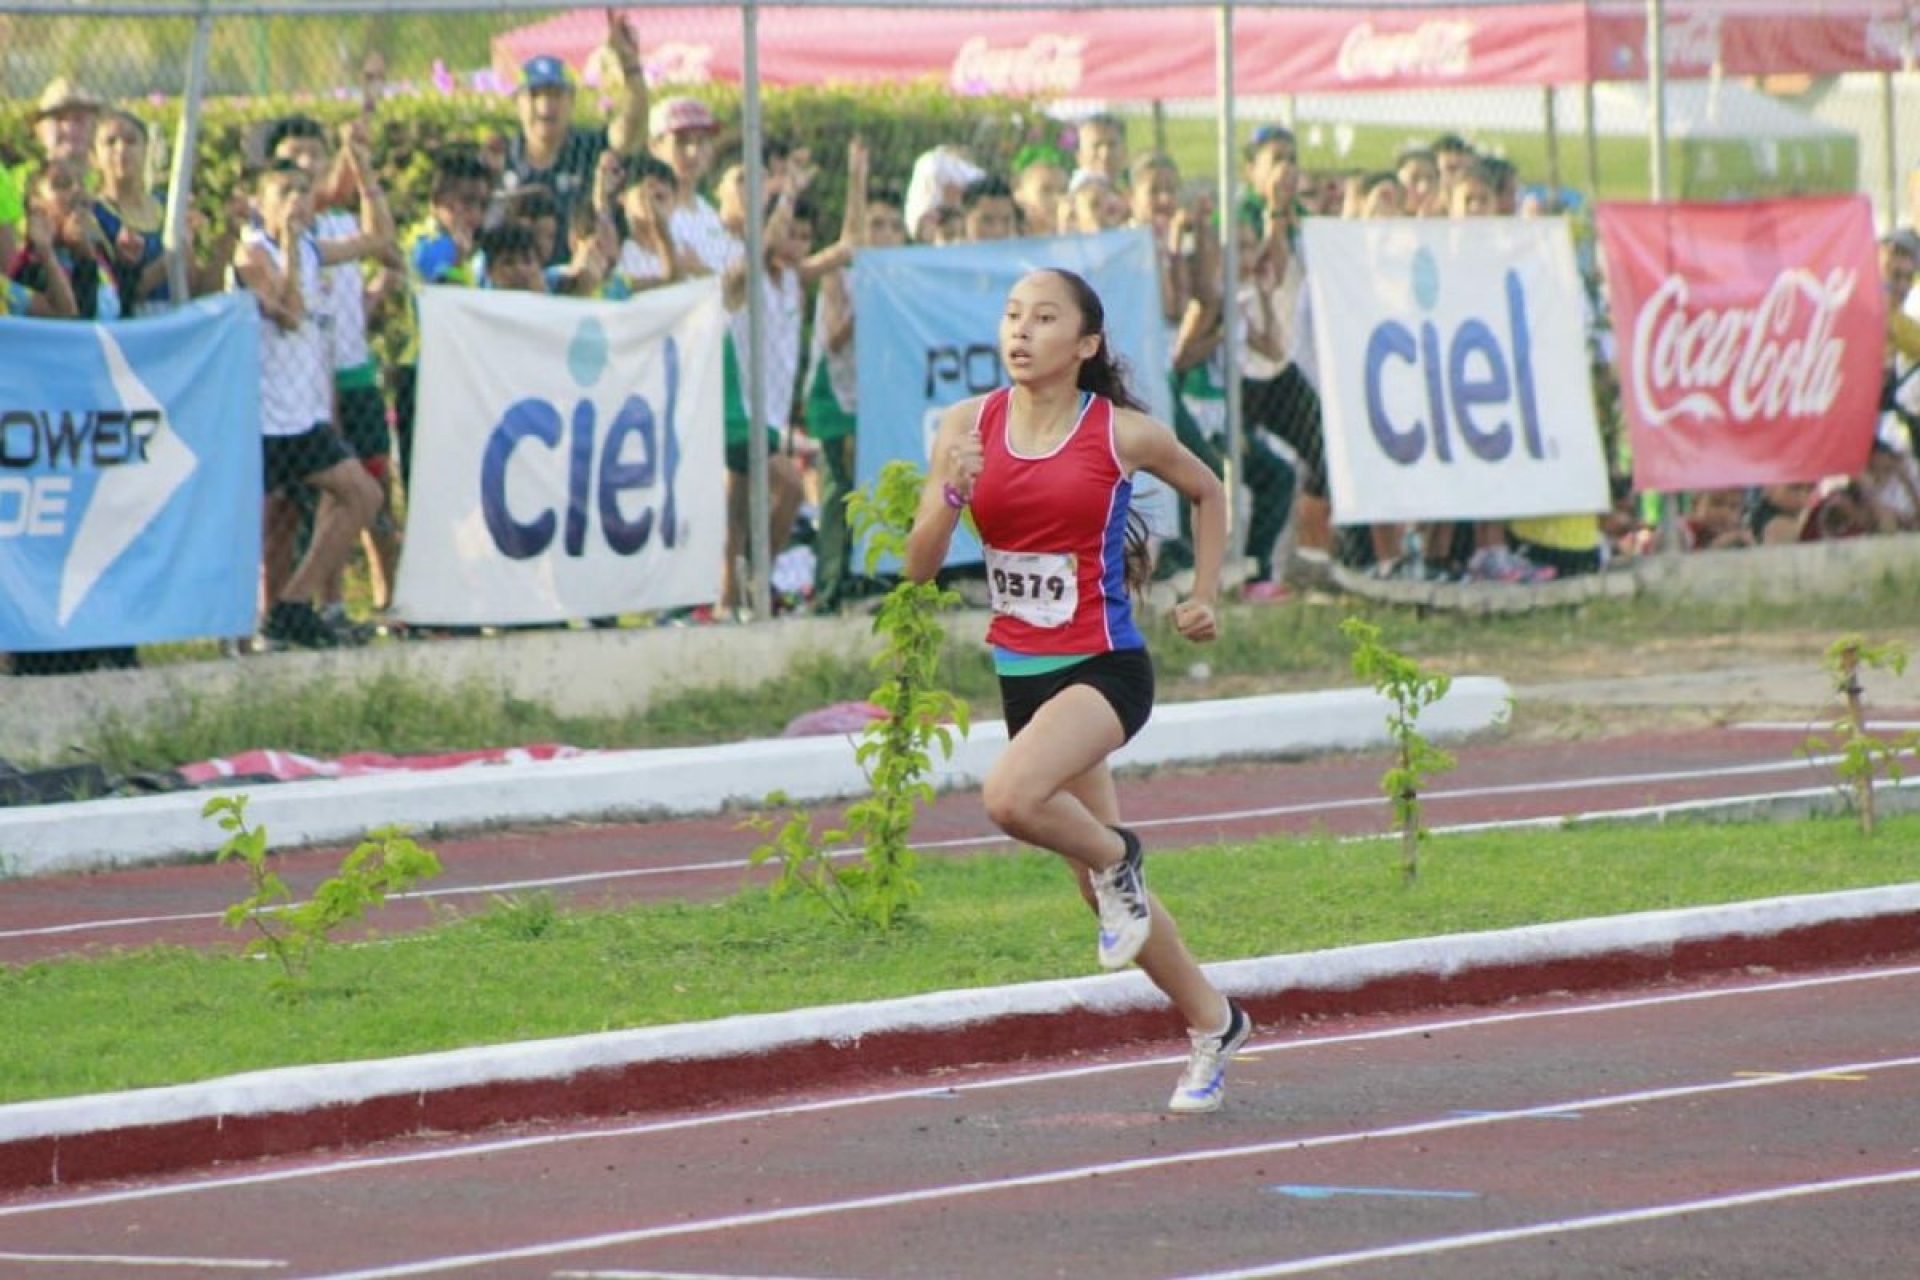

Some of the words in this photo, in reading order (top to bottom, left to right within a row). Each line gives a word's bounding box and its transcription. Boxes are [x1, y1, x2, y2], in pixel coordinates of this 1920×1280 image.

[481, 315, 681, 560] ciel
[1365, 248, 1545, 466] ciel
[993, 568, 1065, 600] 0379
